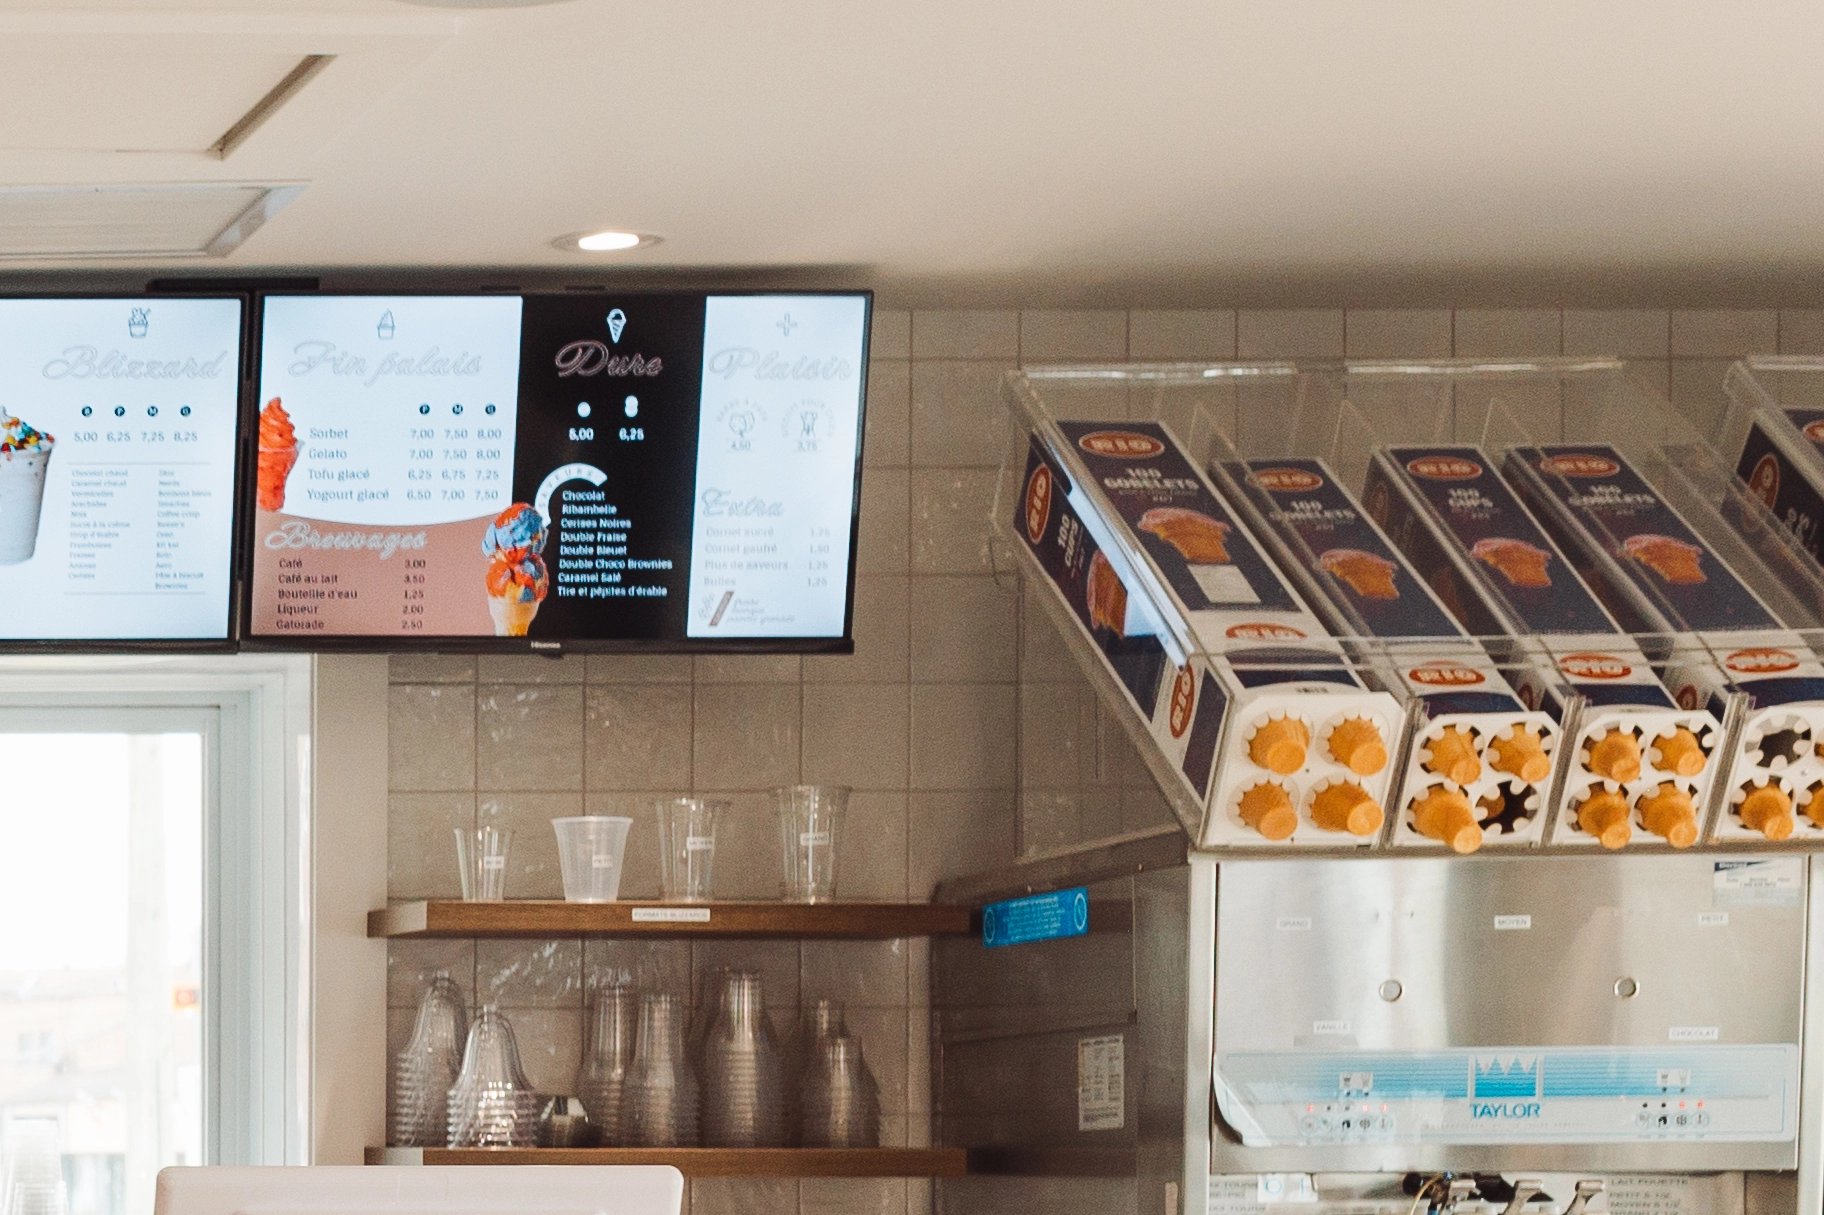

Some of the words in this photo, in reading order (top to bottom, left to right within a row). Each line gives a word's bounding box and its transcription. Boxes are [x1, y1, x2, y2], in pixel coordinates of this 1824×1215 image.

[43, 344, 228, 379] Blizzard
[555, 340, 663, 377] Dure
[310, 429, 348, 438] Sorbet
[1090, 438, 1152, 450] RIO
[309, 449, 347, 459] Gelato
[1419, 462, 1475, 474] RIO
[308, 469, 334, 480] Tofu
[338, 469, 370, 482] glacé
[307, 489, 353, 501] Yogourt
[357, 489, 389, 501] glacé
[563, 491, 605, 501] Chocolat
[1030, 476, 1046, 531] RIO
[562, 504, 617, 514] Ribambelle
[561, 518, 597, 528] Cerises
[599, 518, 631, 528] Noires
[1058, 514, 1069, 548] 100
[561, 532, 595, 542] Double
[597, 532, 627, 542] Fraise
[1065, 519, 1079, 567] CUPS
[560, 545, 594, 555] Double
[597, 545, 627, 555] Bleuet
[280, 559, 302, 568] Café
[559, 559, 593, 569] Double
[595, 559, 625, 569] Choco
[628, 558, 672, 569] Brownies
[746, 562, 788, 570] saveurs
[279, 574, 301, 584] Café
[304, 576, 317, 584] au
[321, 574, 338, 584] lait
[558, 572, 598, 582] Caramel
[602, 572, 621, 582] Salé
[278, 590, 325, 599] Bouteille
[558, 586, 575, 596] Tire
[578, 587, 587, 596] et
[590, 585, 626, 598] pépites
[277, 605, 318, 616] Liqueur
[277, 620, 324, 629] Gatorade
[1418, 669, 1477, 683] RIO
[1173, 672, 1192, 730] RIO
[1497, 918, 1527, 926] MOYEN
[1316, 1023, 1348, 1032] VANILLE
[1671, 1029, 1716, 1038] CHOCOLAT
[1470, 1102, 1542, 1119] TAYLOR
